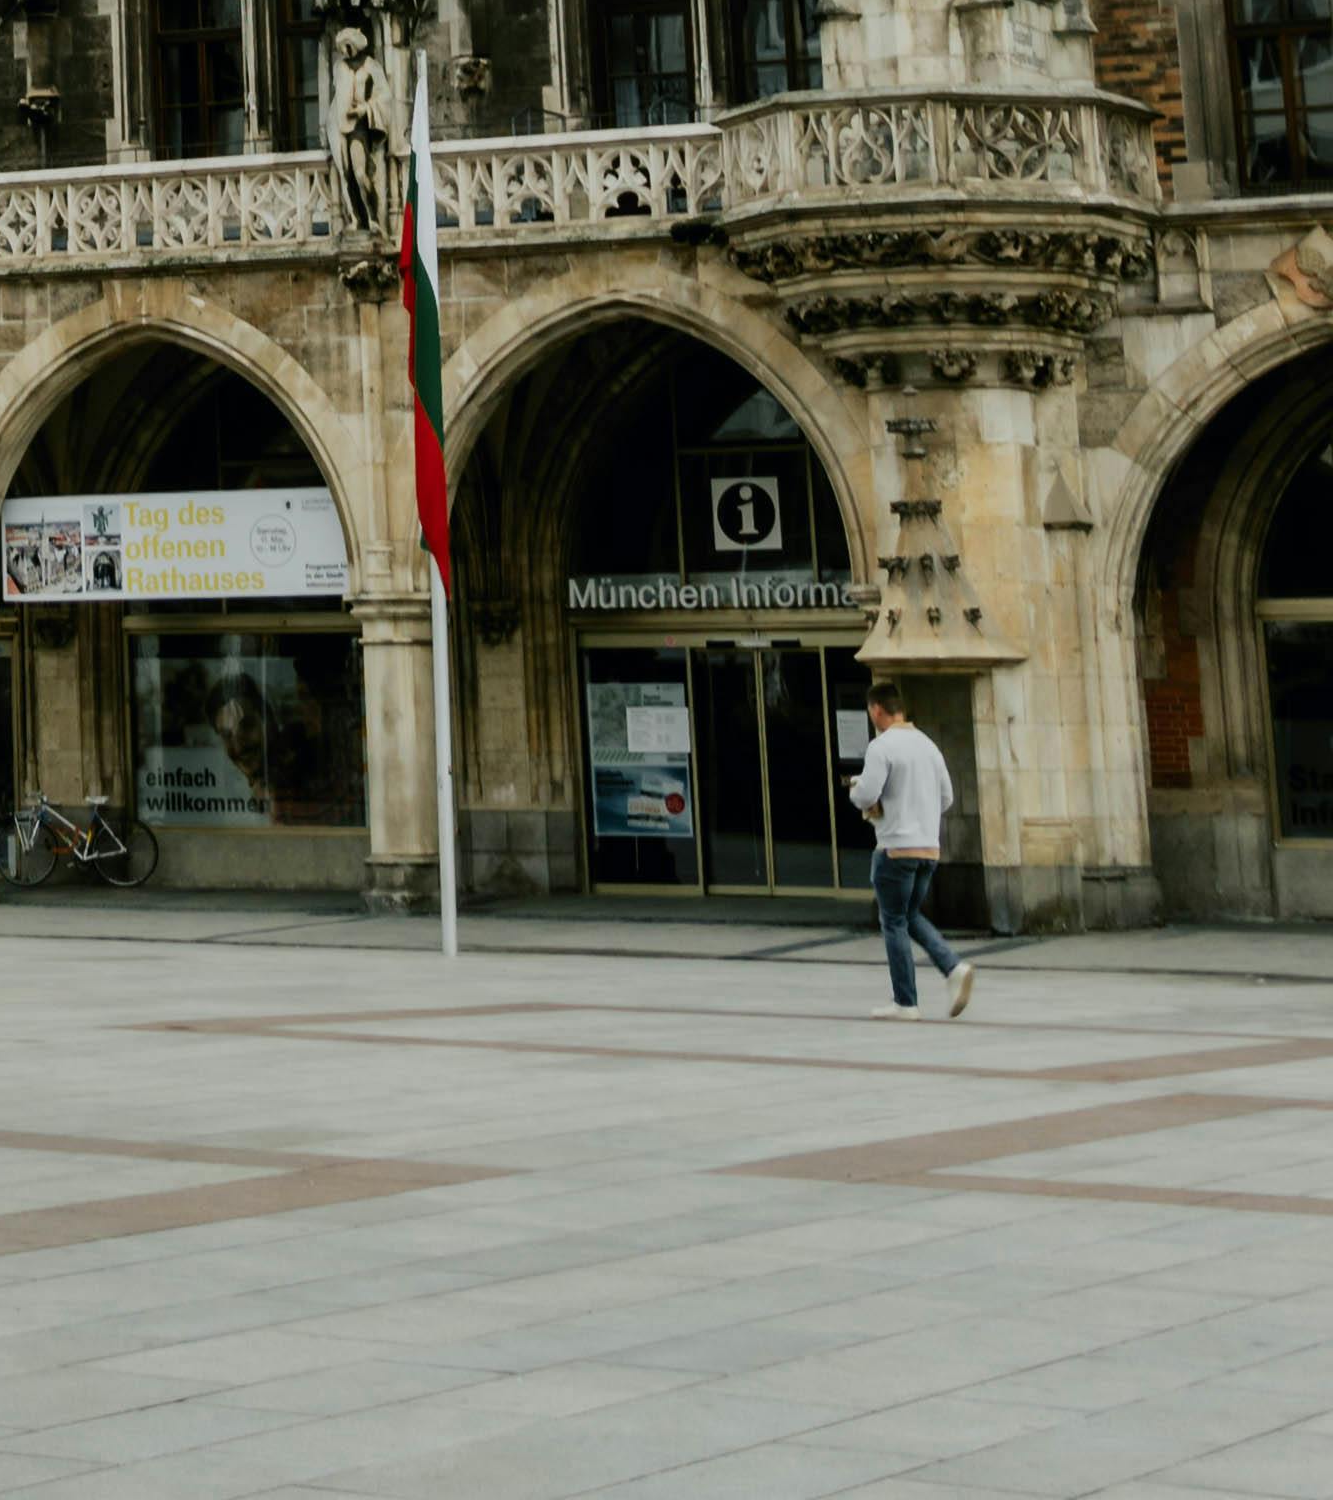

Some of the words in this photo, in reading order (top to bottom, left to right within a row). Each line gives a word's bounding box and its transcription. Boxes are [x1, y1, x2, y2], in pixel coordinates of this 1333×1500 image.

[124, 502, 170, 531] Tag
[178, 500, 225, 526] des
[125, 536, 226, 561] offenen
[126, 567, 265, 594] Rathauses
[569, 577, 719, 609] München
[146, 766, 216, 787] einfach
[146, 791, 269, 813] willkommen
